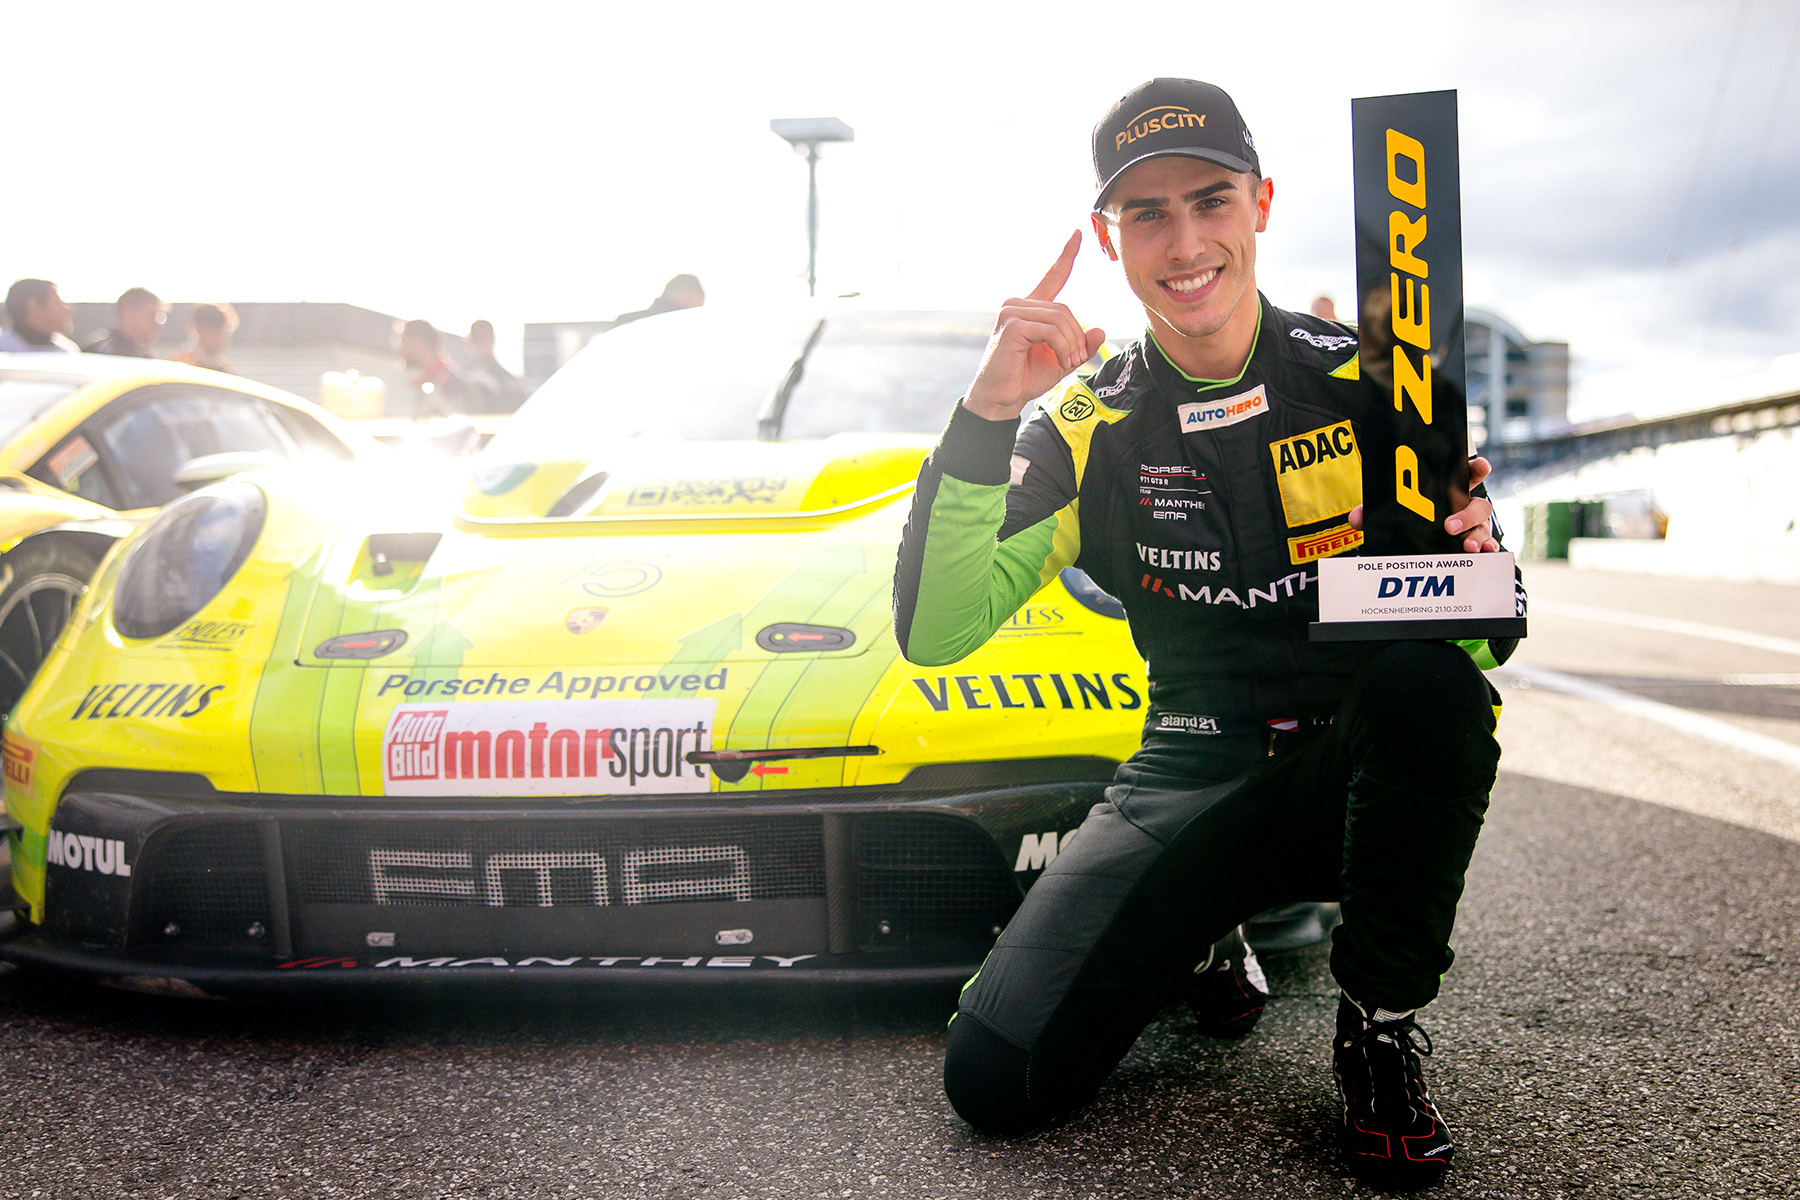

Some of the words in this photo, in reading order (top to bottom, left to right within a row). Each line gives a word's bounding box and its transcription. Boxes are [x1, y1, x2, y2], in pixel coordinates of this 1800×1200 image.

[1385, 127, 1433, 426] ZERO
[1186, 395, 1263, 424] AUTOHERO
[1279, 425, 1354, 474] ADAC
[1395, 444, 1435, 522] P
[1135, 542, 1222, 571] VELTINS
[1296, 528, 1363, 558] PIRELL
[1357, 562, 1383, 571] POLE
[1386, 561, 1433, 570] POSITION
[1436, 559, 1474, 568] AWARD
[1377, 575, 1455, 598] DTM
[1361, 606, 1433, 615] HOCKENHEIMRING
[1434, 605, 1473, 613] 21.10.2023
[377, 672, 531, 697] Porsche
[535, 667, 728, 700] Approved
[911, 673, 1142, 712] VELTINS
[71, 684, 228, 721] VELTINS
[390, 712, 446, 744] Auto
[391, 742, 437, 778] Bild
[47, 828, 132, 877] MOTUL
[375, 954, 818, 968] MANTHEY
